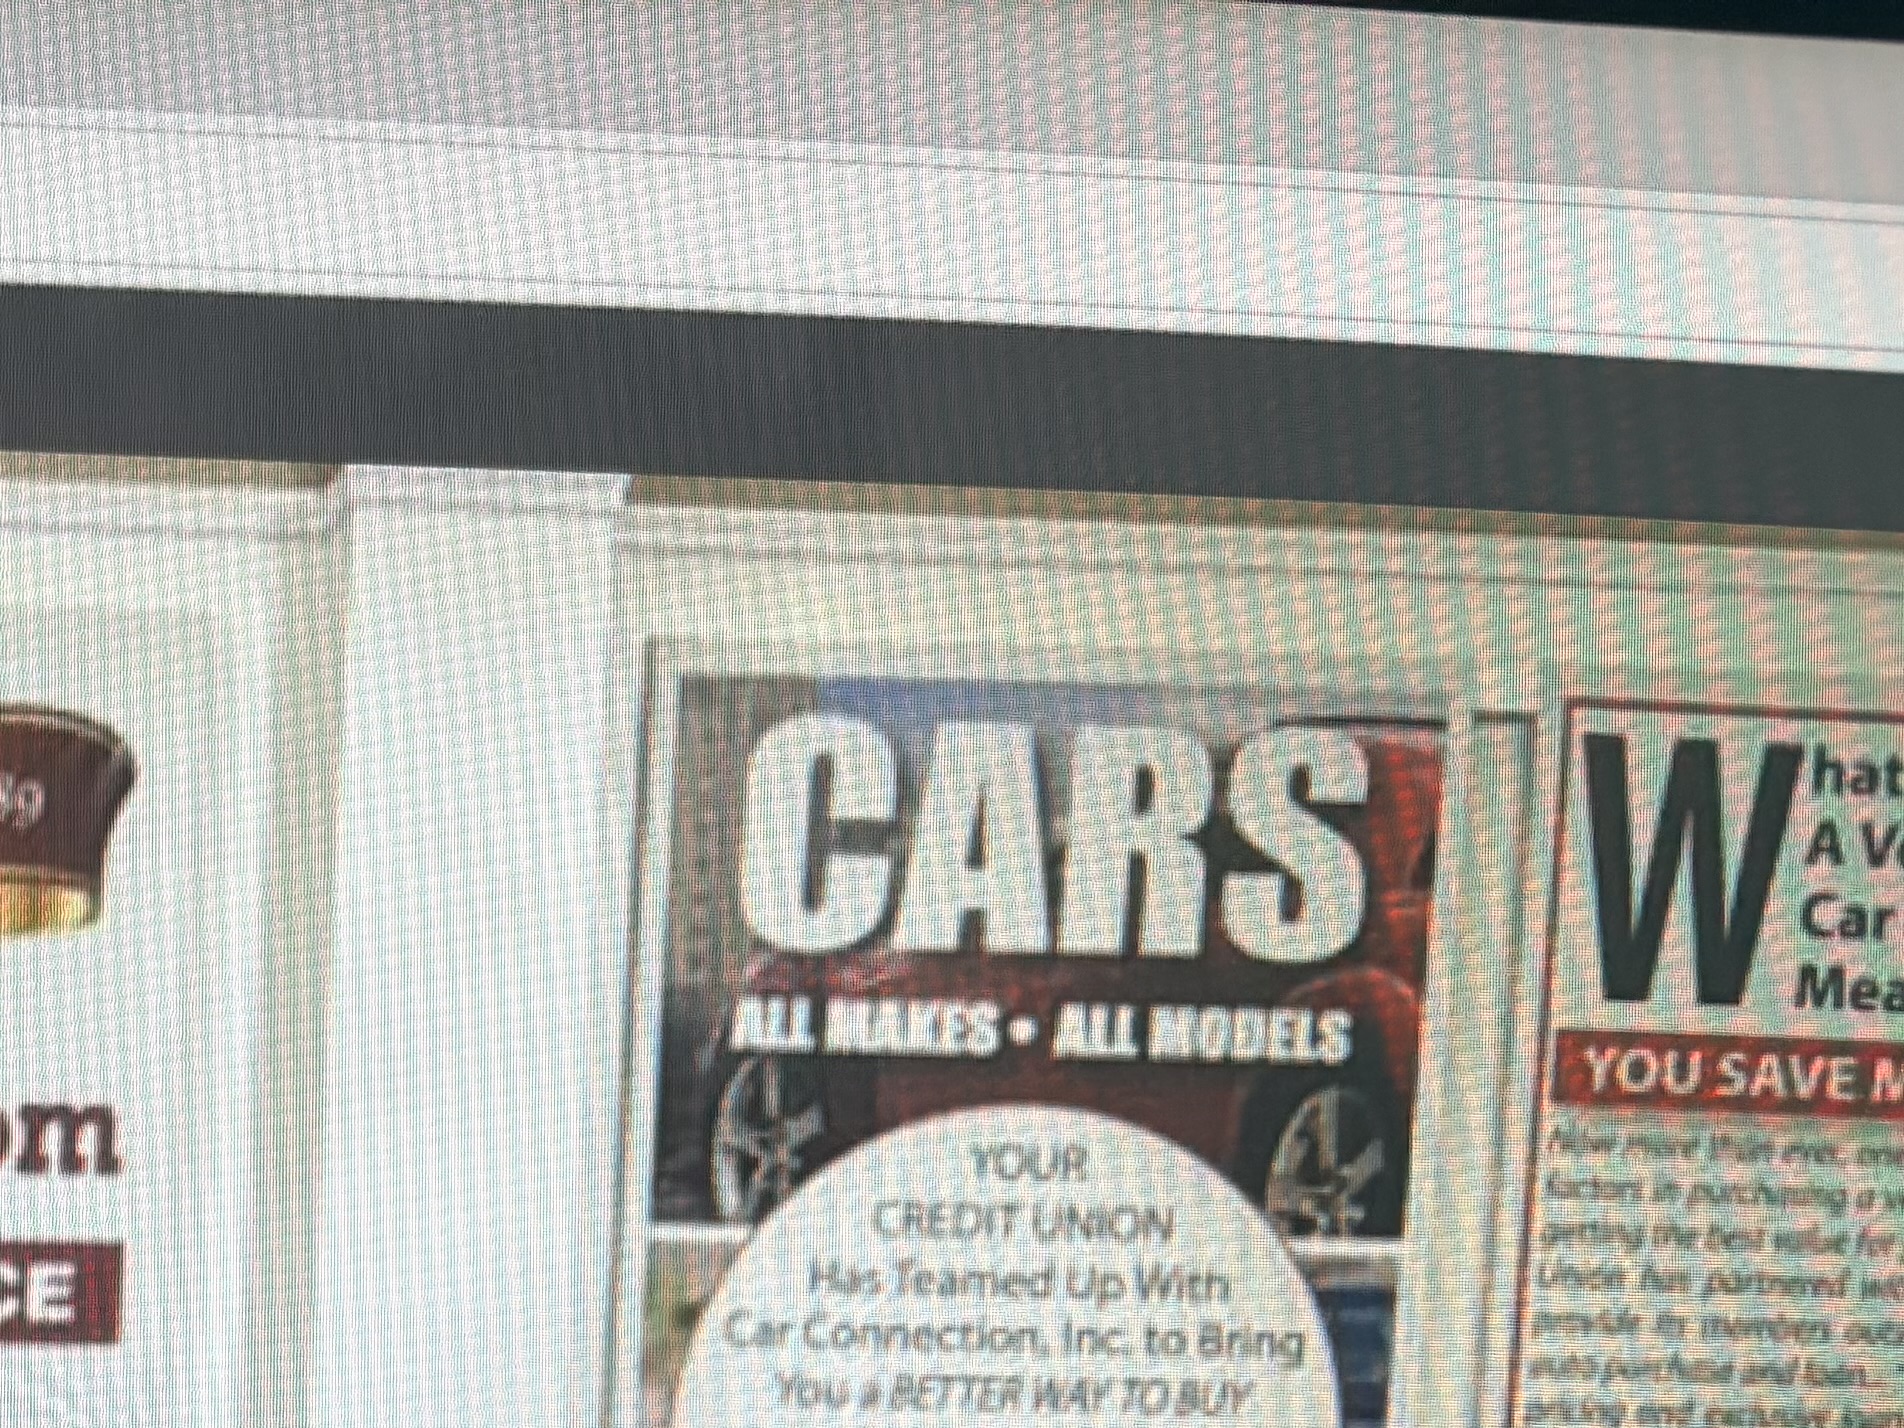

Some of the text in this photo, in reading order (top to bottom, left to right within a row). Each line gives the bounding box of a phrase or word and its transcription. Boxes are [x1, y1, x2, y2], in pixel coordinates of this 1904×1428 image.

[738, 713, 1370, 964] CARS
[1805, 818, 1844, 867] A
[1800, 890, 1894, 941] Car
[729, 995, 1353, 1064] ALL MAKES ALL MODELS
[1582, 1047, 1701, 1093] YOU
[1718, 1052, 1857, 1099] SAVE
[970, 1144, 1088, 1182] YOUR
[871, 1201, 1174, 1242] CREDIT UNION
[808, 1259, 1231, 1306] Has Teamed Up With
[725, 1309, 1306, 1370] Car Connection, Inc. to Bring
[774, 1375, 1254, 1417] You a BETTER WAY TO BUY
